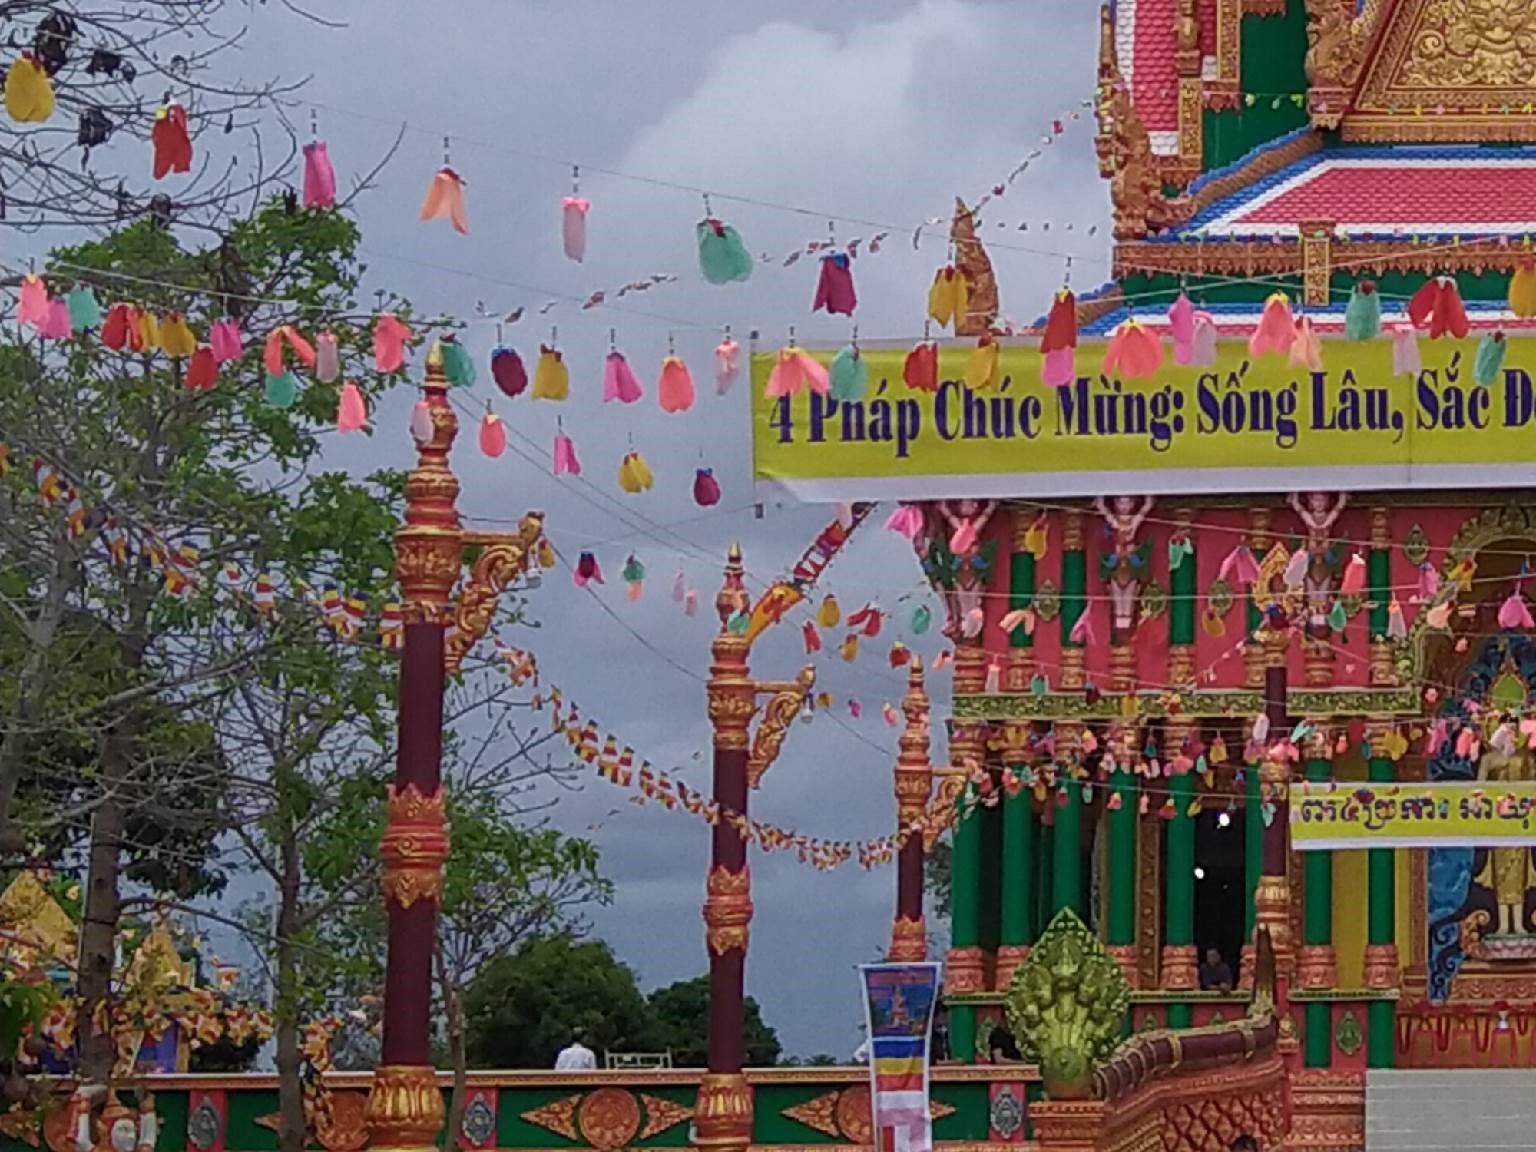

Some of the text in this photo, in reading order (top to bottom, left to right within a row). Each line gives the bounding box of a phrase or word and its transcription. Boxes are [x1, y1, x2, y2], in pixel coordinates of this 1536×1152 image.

[769, 390, 794, 443] 4
[934, 376, 1042, 440] Chúc
[1054, 374, 1185, 452] Mừng:
[1197, 360, 1299, 449] Sống
[1309, 369, 1404, 444] Lâu,
[1416, 351, 1490, 430] Sắc
